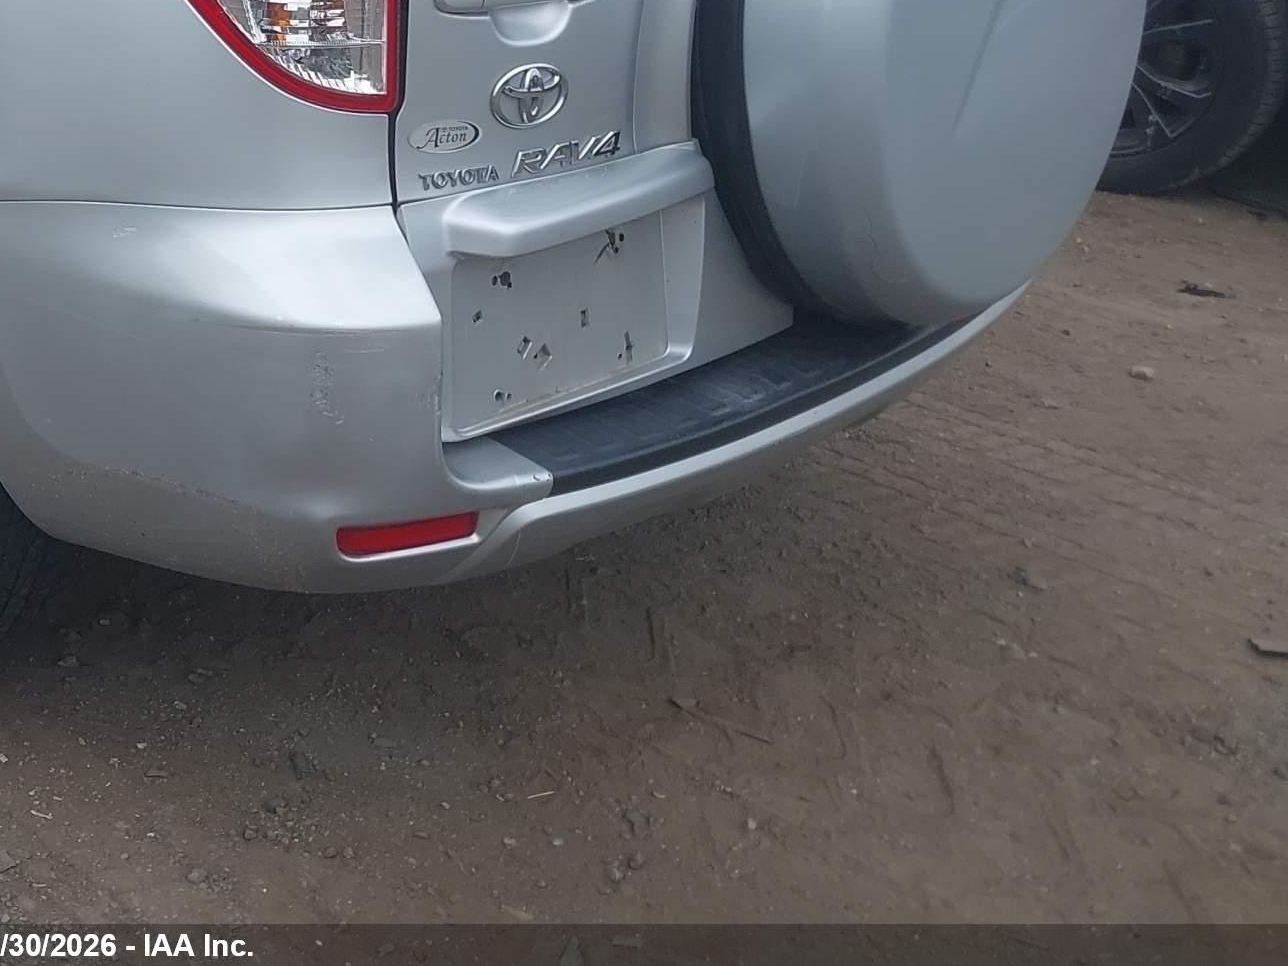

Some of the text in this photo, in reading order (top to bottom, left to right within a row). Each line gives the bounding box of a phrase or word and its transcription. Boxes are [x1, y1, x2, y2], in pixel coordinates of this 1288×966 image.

[416, 127, 467, 149] Acton
[418, 131, 621, 191] TOYOTA RAV4
